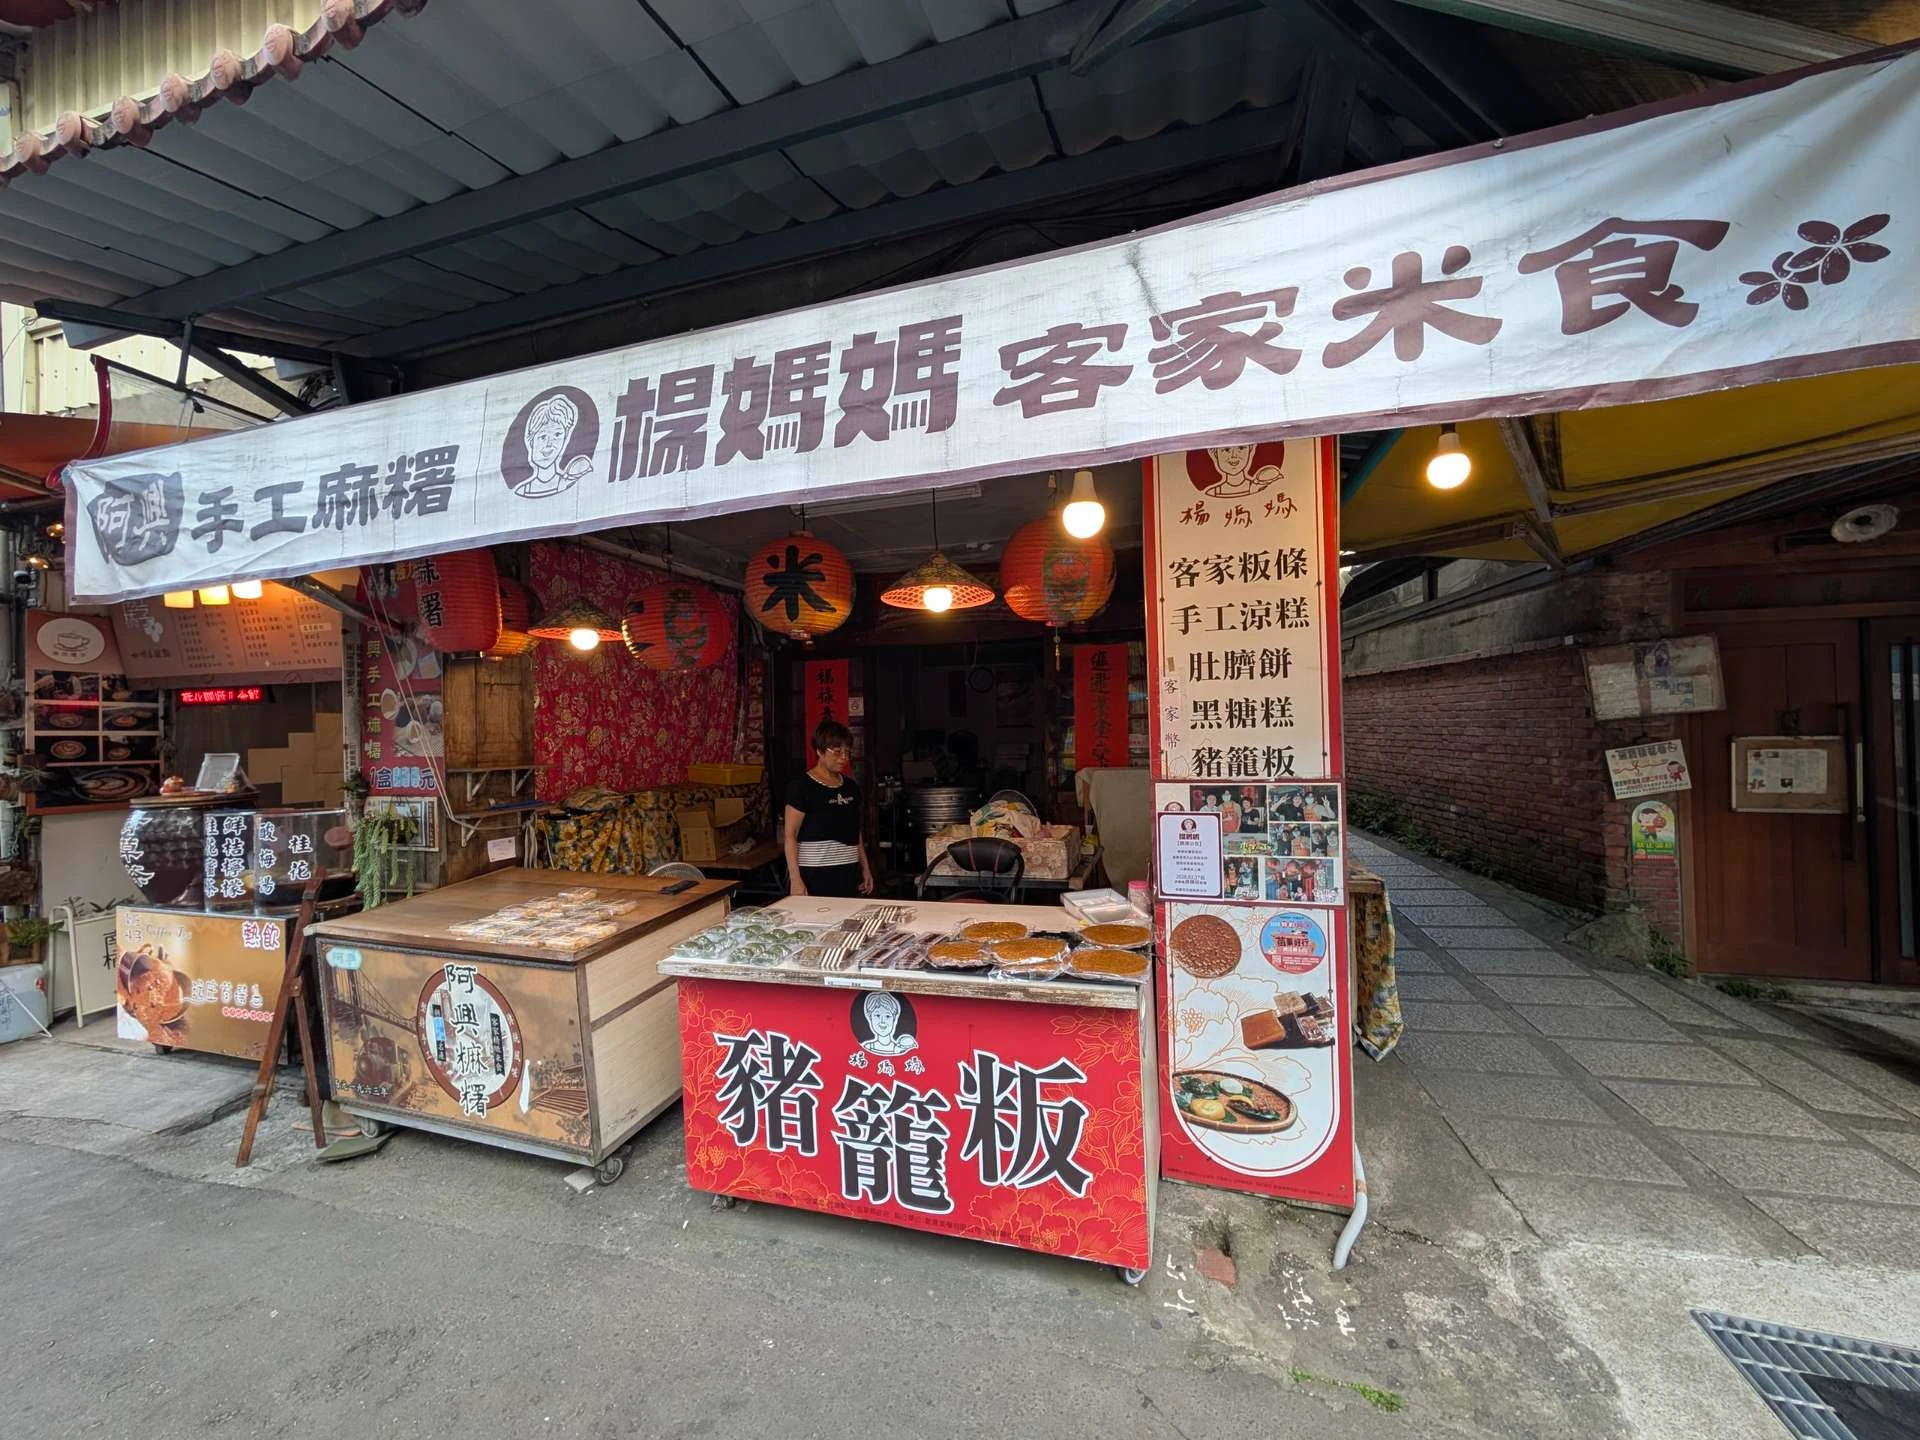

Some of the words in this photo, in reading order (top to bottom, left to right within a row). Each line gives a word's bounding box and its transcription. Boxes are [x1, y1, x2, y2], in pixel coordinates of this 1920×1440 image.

[608, 314, 963, 482] 楊媽媽
[992, 216, 1731, 418] 客家米食
[96, 479, 170, 552] 阿興
[190, 444, 460, 554] 手工麻糬
[1179, 492, 1298, 528] 楊媽媽
[760, 545, 836, 622] 米
[1168, 547, 1308, 588] 客家粄條
[1170, 596, 1310, 636] 手工涼糕
[1188, 647, 1293, 683] 肚臍餅
[1163, 678, 1181, 749] 客家幣
[1189, 696, 1295, 730] 黑糖糕
[1191, 744, 1296, 778] 豬籠粄
[288, 834, 314, 881] 桂花
[241, 920, 280, 950] 熱飲
[848, 1050, 926, 1078] 楊媽媽
[713, 1028, 1093, 1215] 豬籠粄
